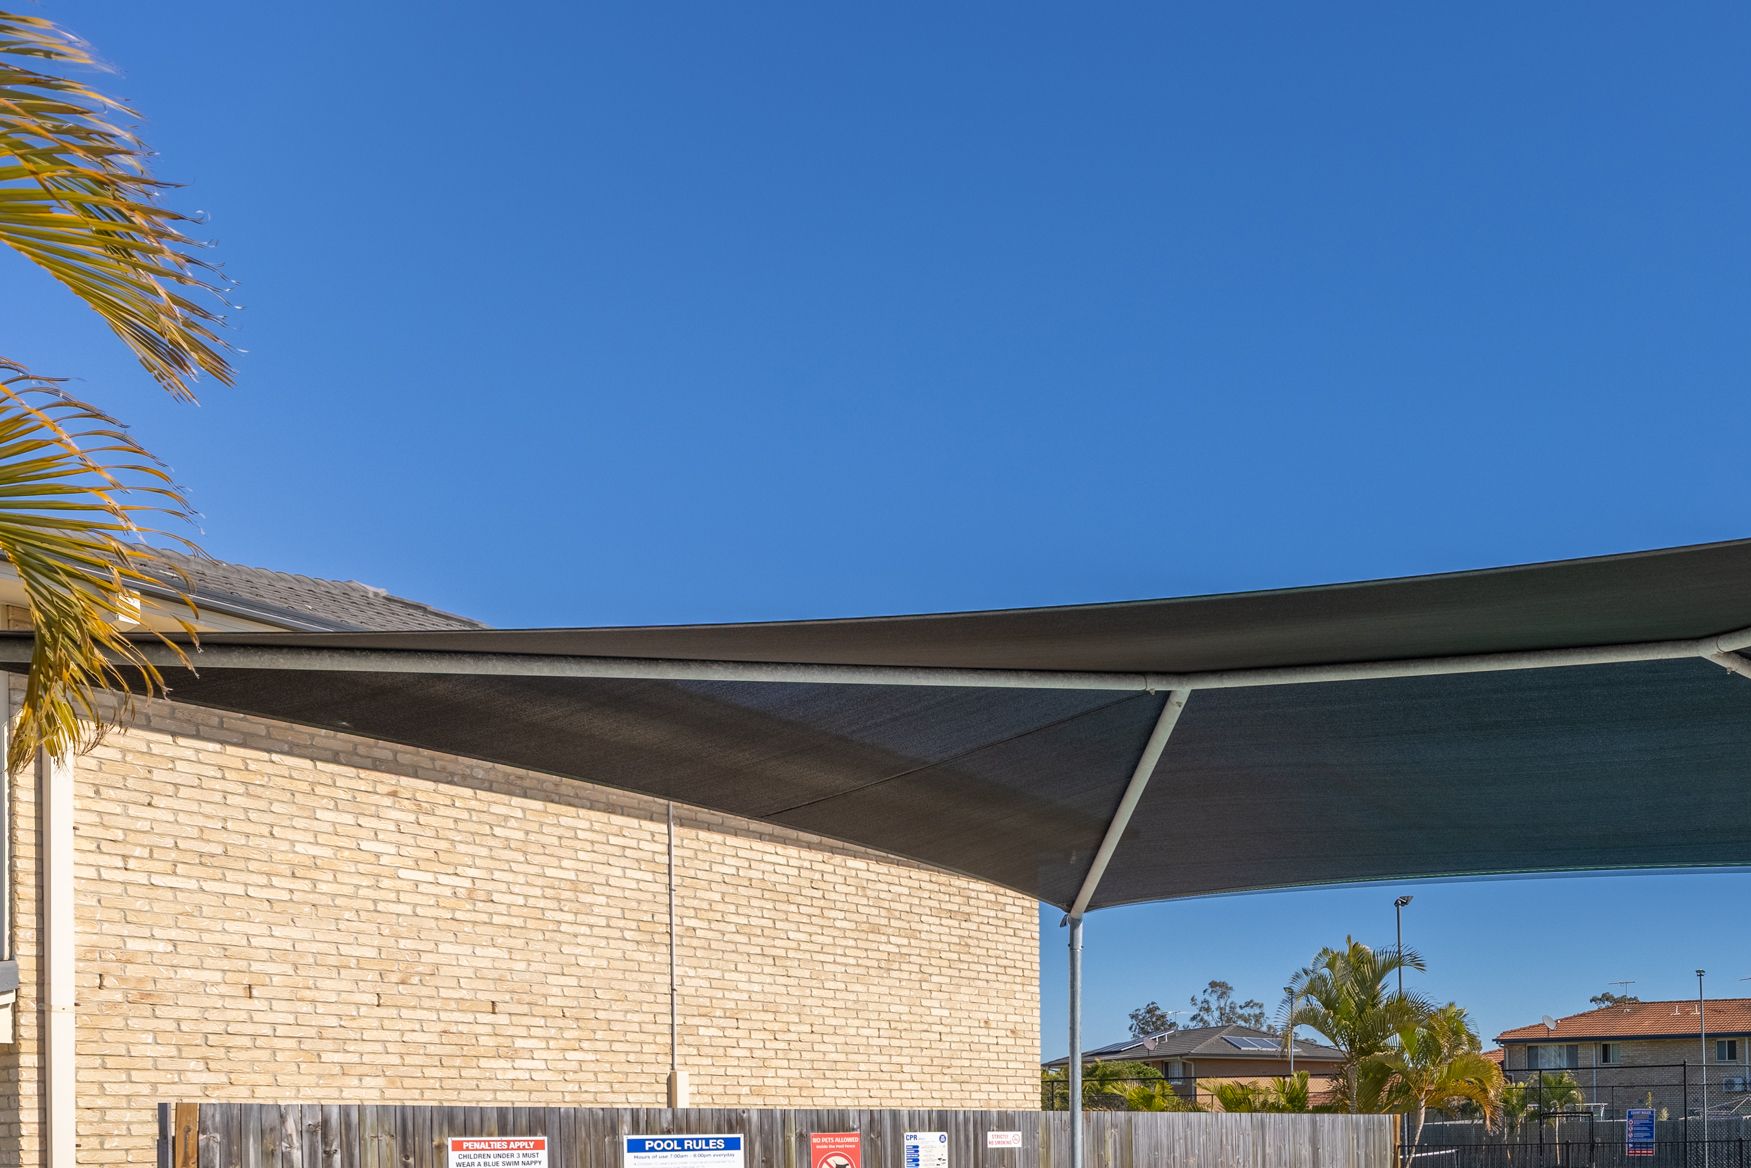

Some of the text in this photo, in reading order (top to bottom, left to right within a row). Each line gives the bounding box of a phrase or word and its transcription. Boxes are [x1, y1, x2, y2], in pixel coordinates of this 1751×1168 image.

[463, 1141, 535, 1150] PENALTIES APPLY
[645, 1139, 725, 1151] POOL RULES
